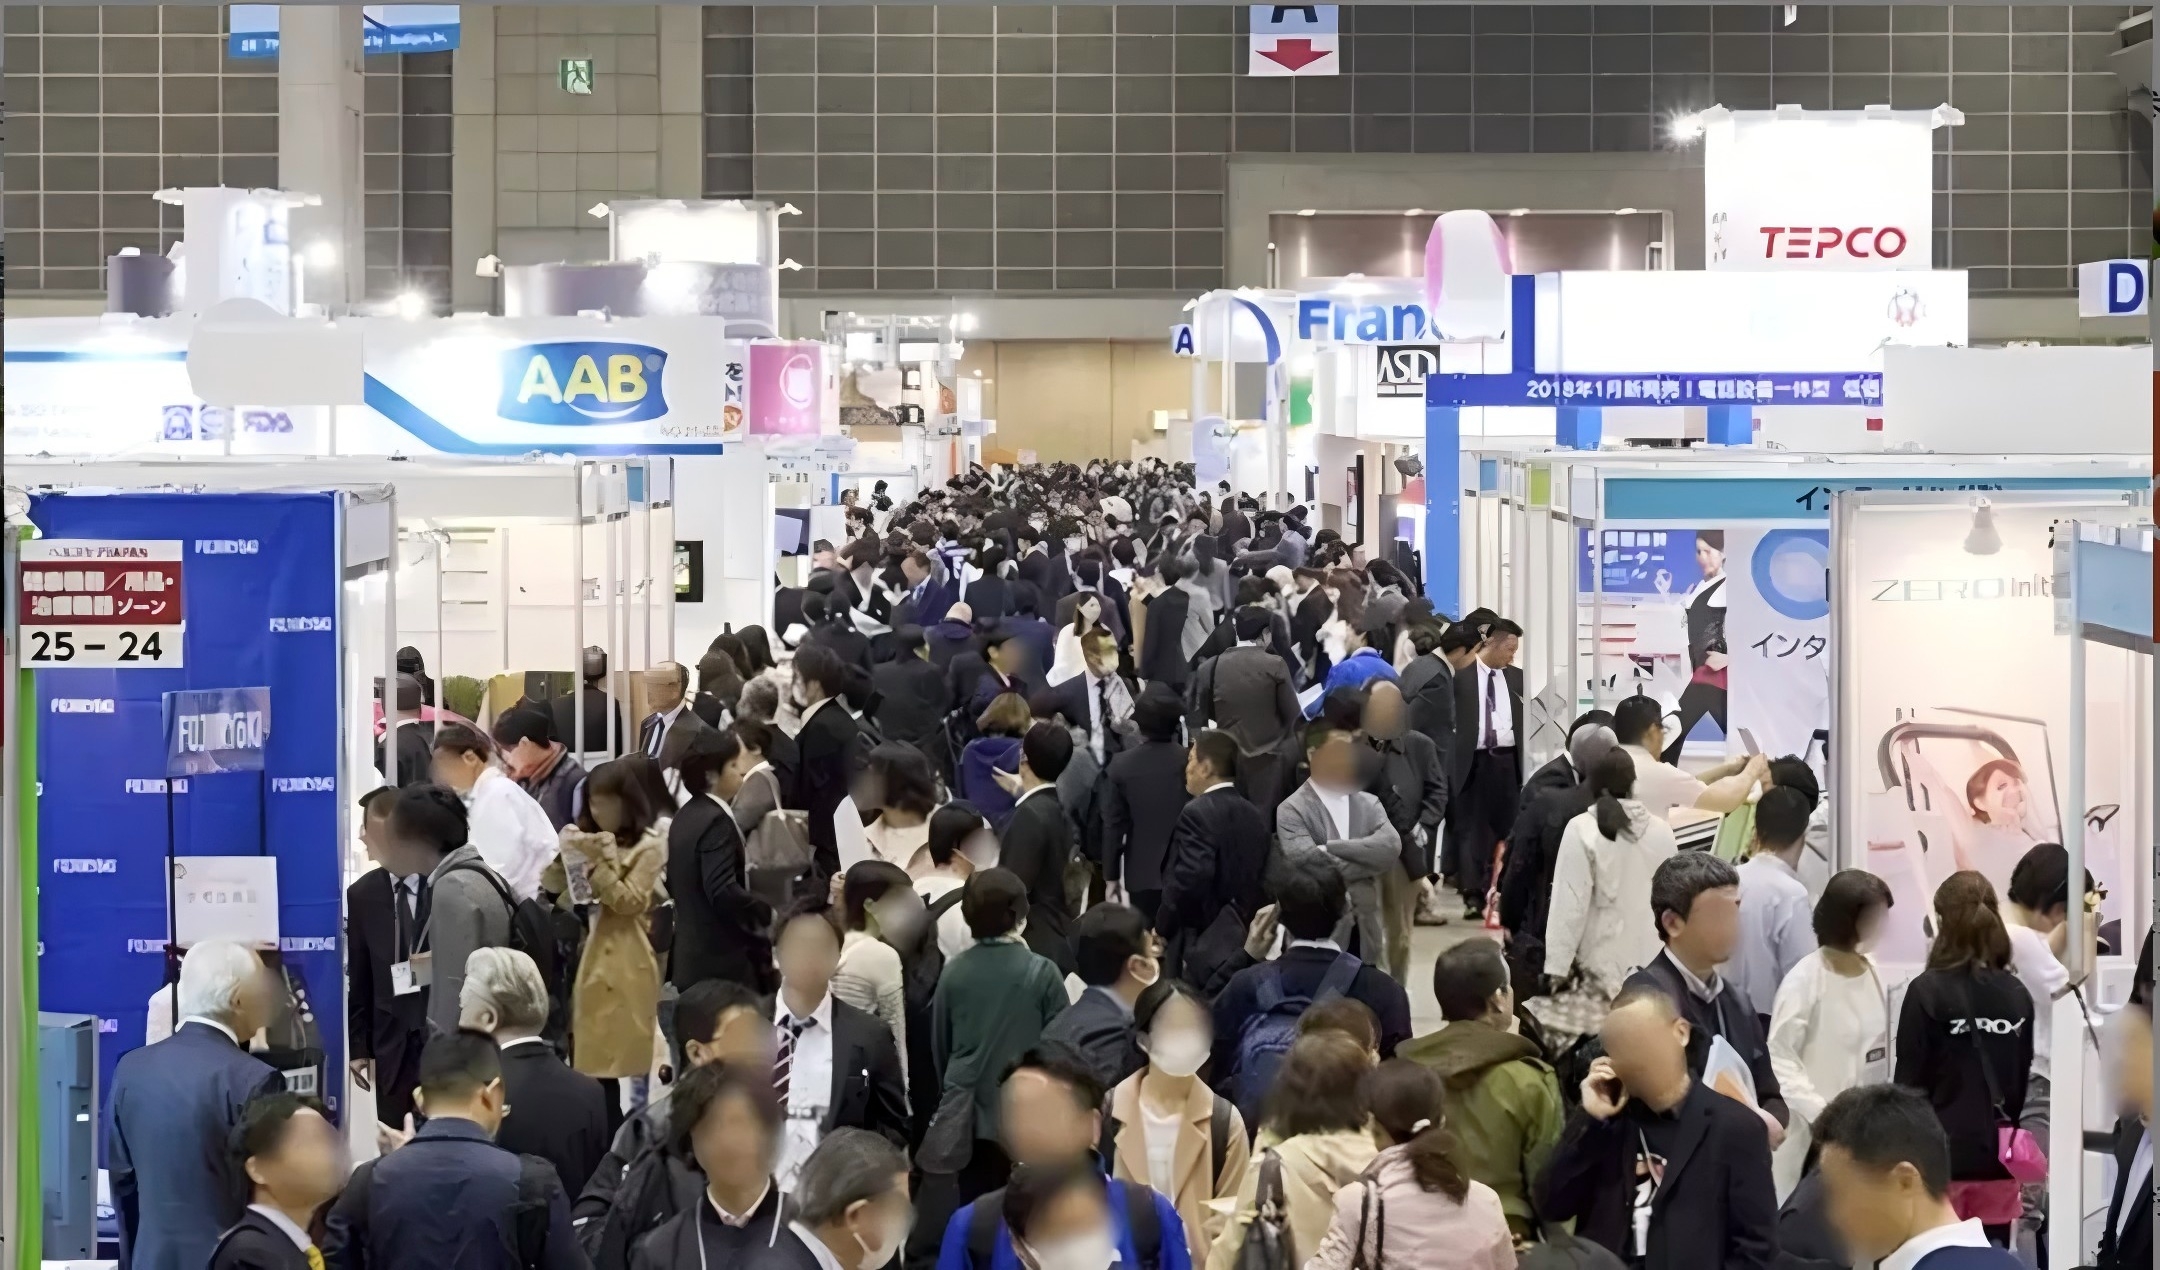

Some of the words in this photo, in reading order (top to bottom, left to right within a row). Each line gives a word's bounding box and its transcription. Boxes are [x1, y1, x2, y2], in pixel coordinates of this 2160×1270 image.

[1759, 227, 1907, 259] TEPCO
[2108, 263, 2144, 313] D
[1298, 299, 1444, 341] Fran
[1175, 326, 1194, 354] A
[516, 353, 649, 404] AAB
[31, 631, 76, 662] 25
[117, 631, 163, 662] 24
[1949, 1017, 2013, 1035] ZRO
